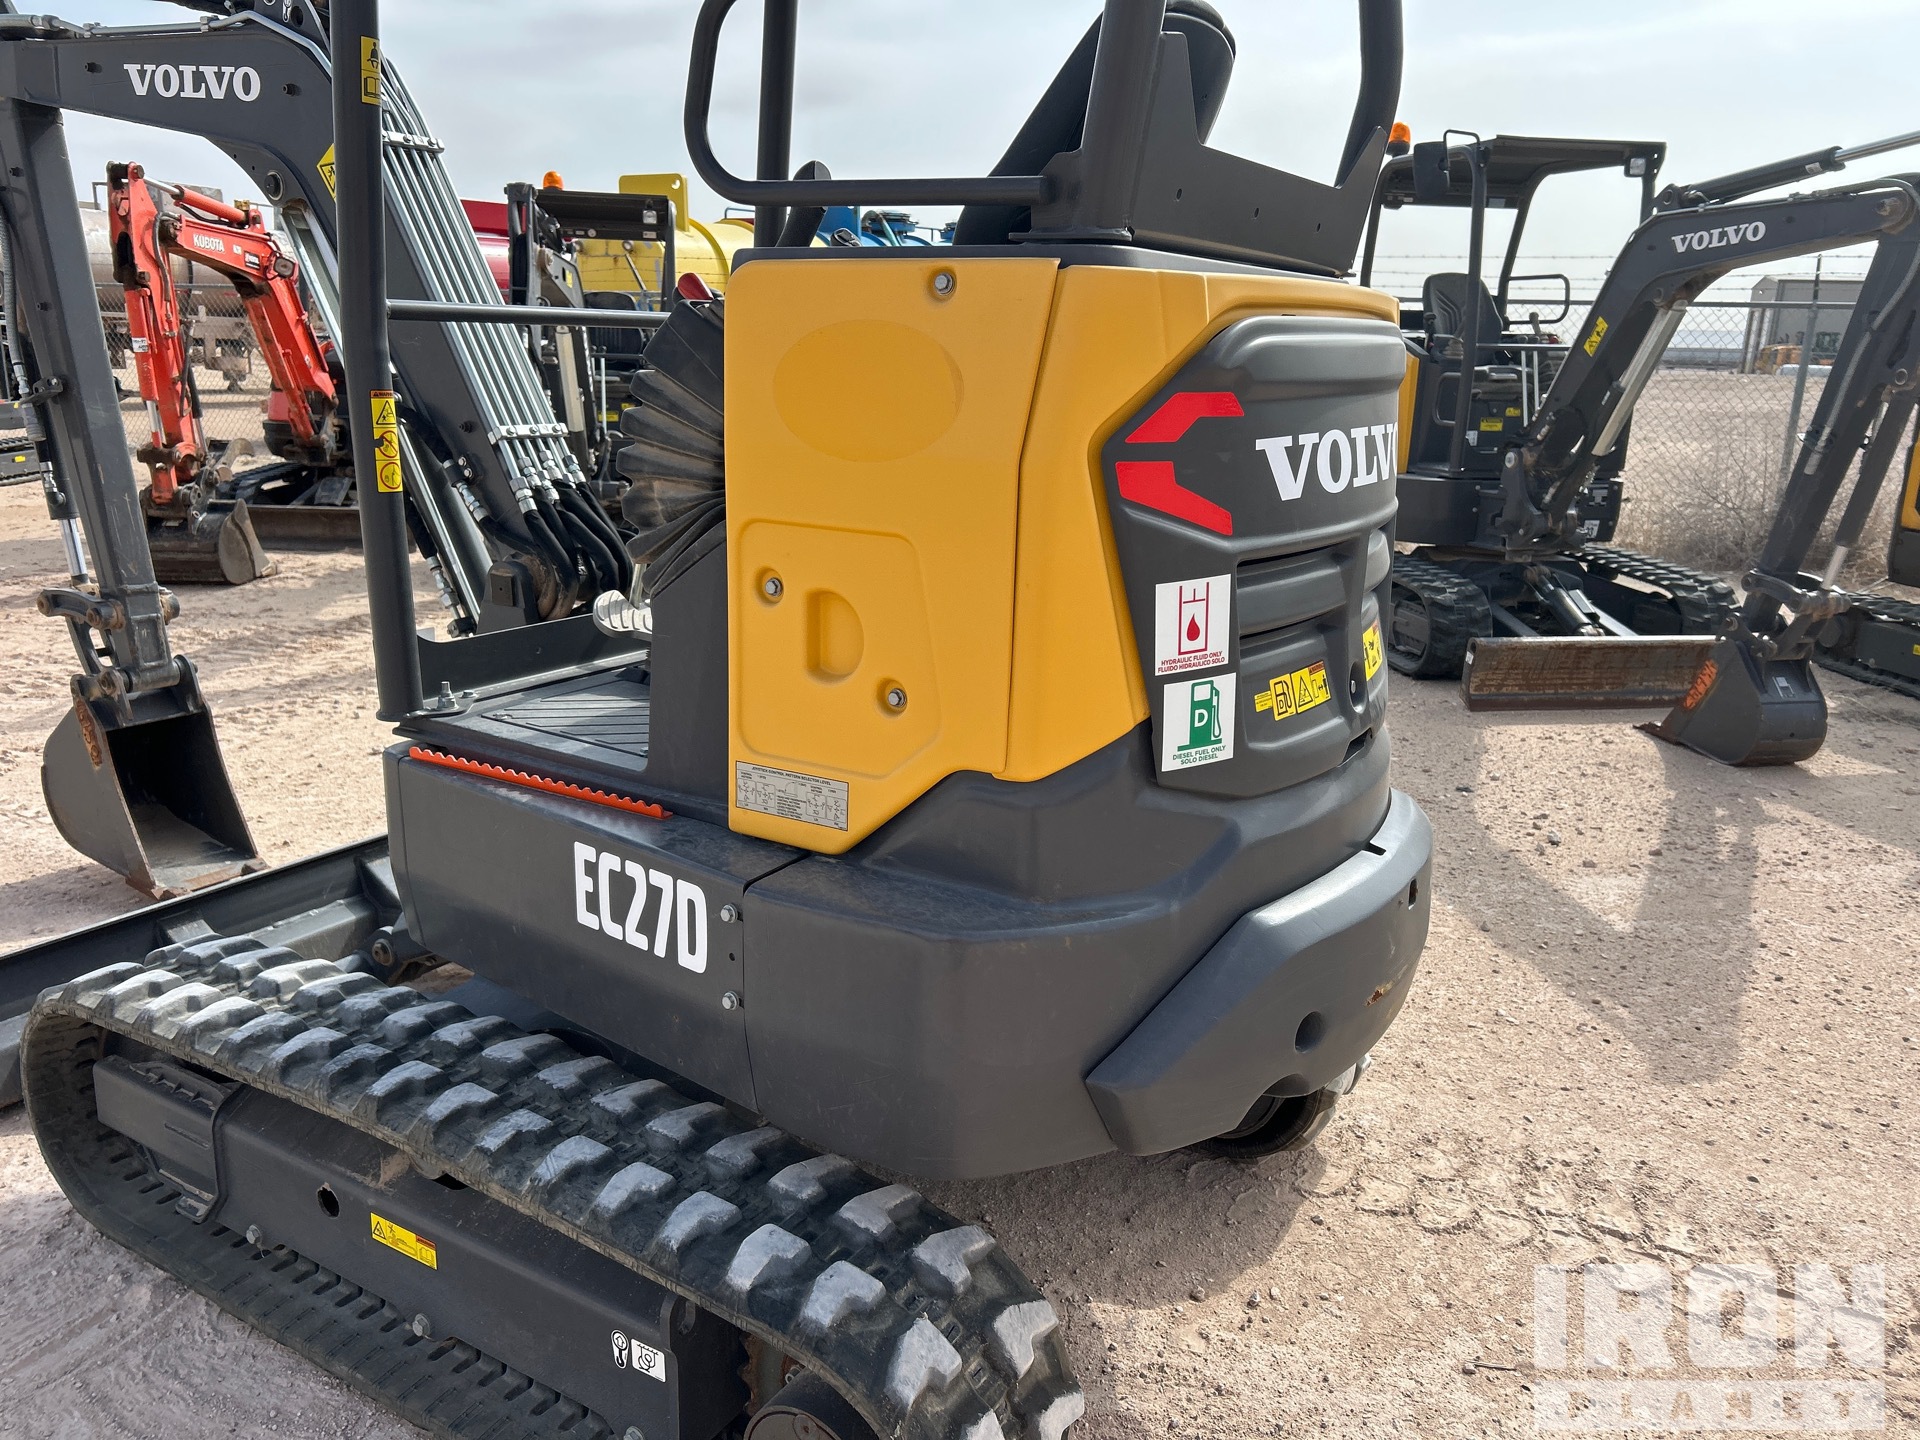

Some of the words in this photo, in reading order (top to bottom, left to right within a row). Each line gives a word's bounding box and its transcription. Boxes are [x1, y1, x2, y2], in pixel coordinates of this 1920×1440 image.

[123, 63, 261, 102] VOLVO
[192, 233, 225, 252] KUBOTA
[1671, 221, 1766, 253] VOLVO
[1157, 665, 1179, 673] FLUIDO
[1179, 660, 1211, 670] HIDRAULICO
[1211, 657, 1225, 665] SOLO
[1160, 655, 1192, 666] HYDRAULIC
[1193, 653, 1208, 661] FLUID
[1209, 651, 1223, 659] ONLY
[1194, 708, 1209, 728] D
[1172, 751, 1194, 761] DIESEL
[1195, 748, 1210, 757] FUEL
[1210, 744, 1226, 753] ONLY
[1180, 756, 1198, 765] SOLO
[1198, 753, 1218, 762] DIESEL
[573, 841, 708, 974] EC27D
